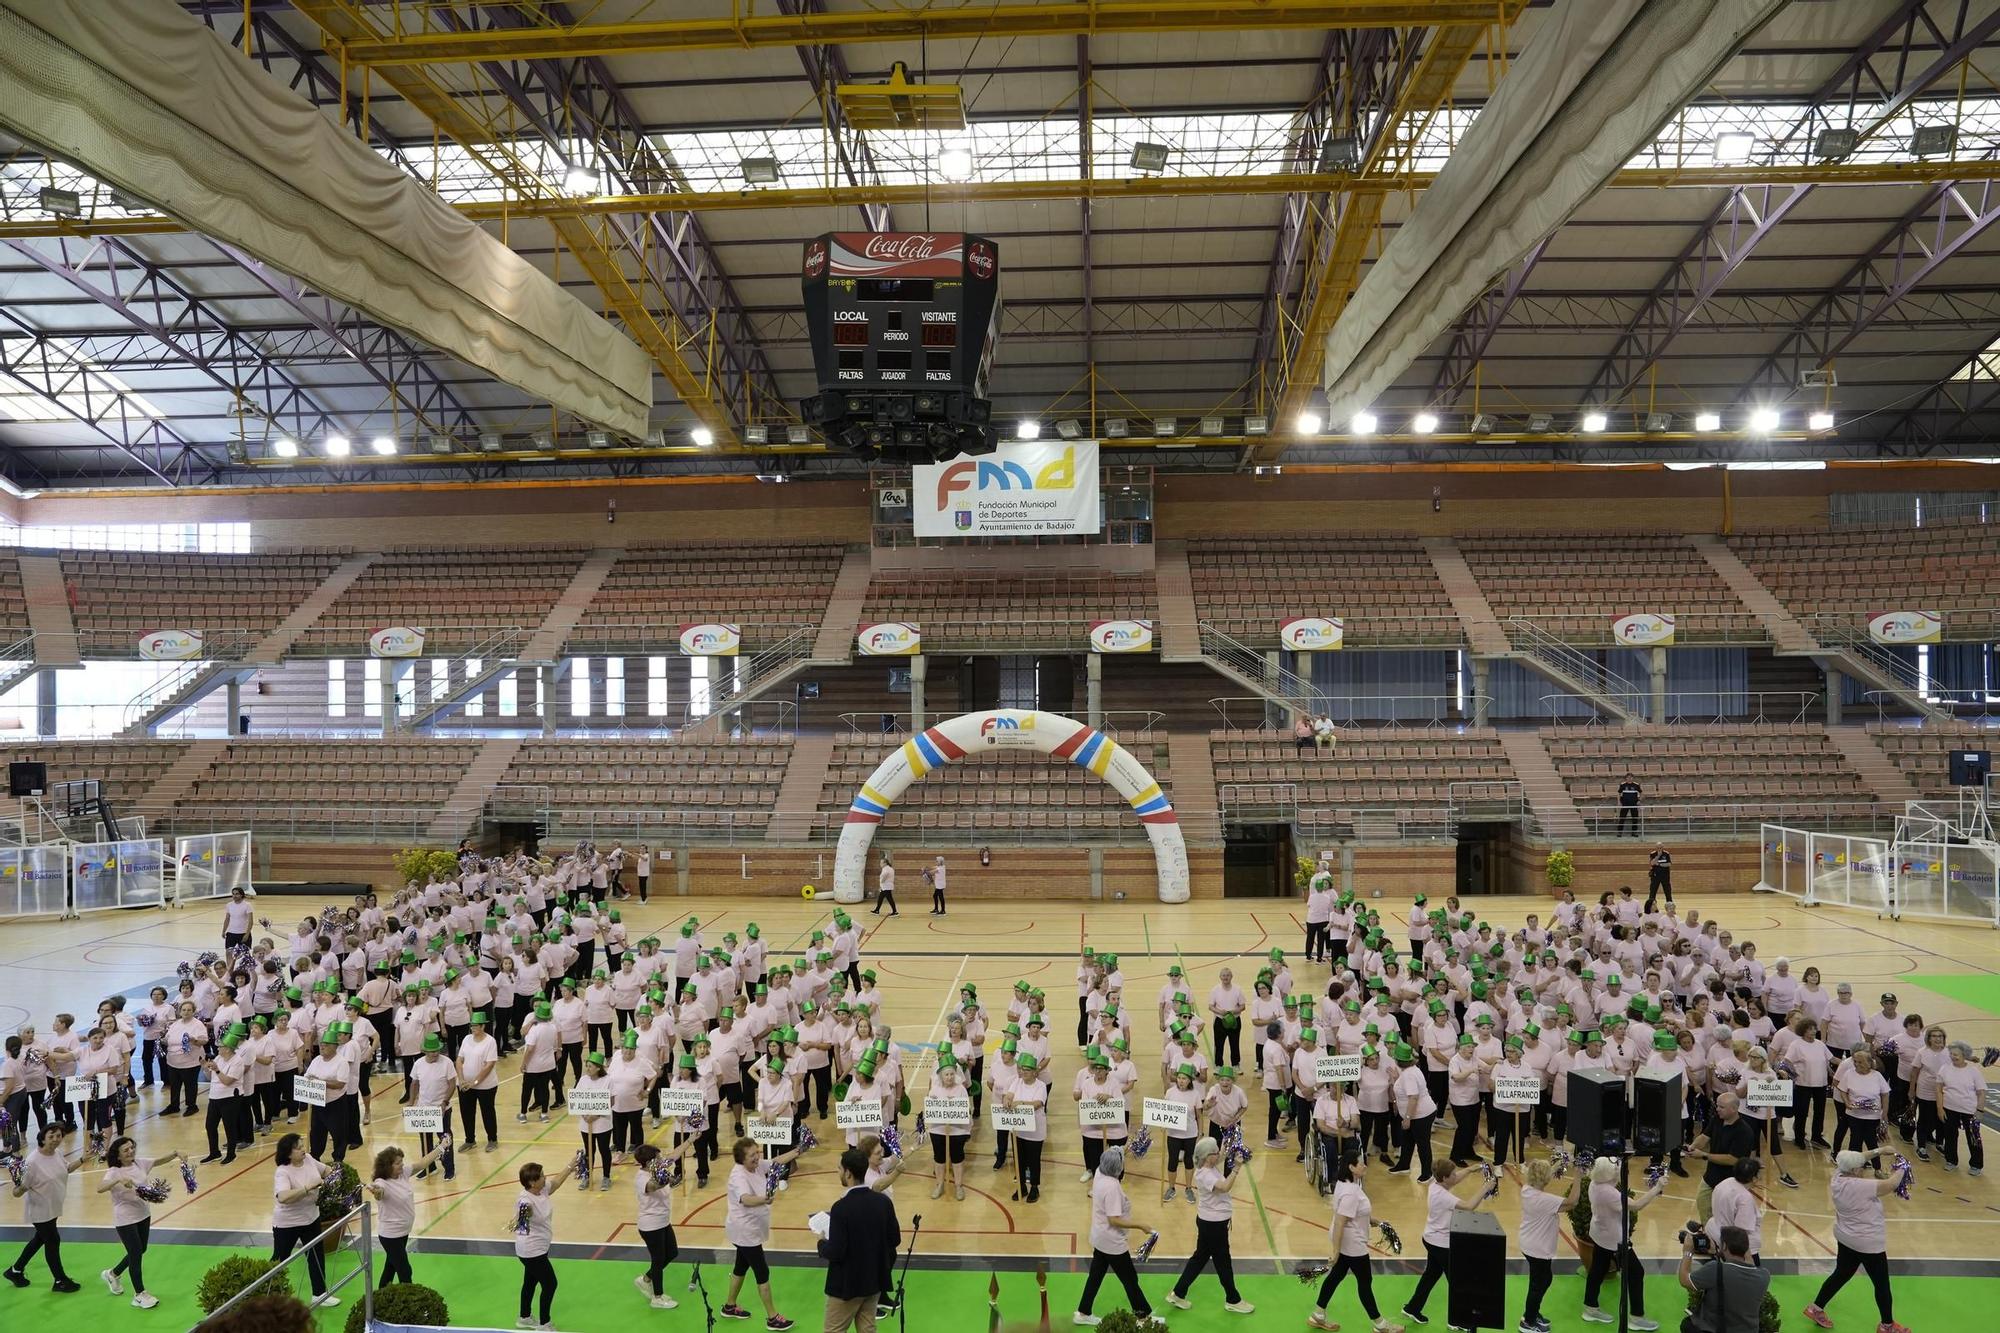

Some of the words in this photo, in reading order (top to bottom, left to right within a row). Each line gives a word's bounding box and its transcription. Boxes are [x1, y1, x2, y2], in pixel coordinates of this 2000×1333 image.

[834, 312, 869, 321] LOCAL
[922, 312, 956, 322] VISITANTE
[883, 332, 909, 340] PERIODO
[838, 371, 864, 380] FALTAS
[881, 372, 906, 380] JUGADOR
[926, 372, 951, 381] FALTAS
[978, 500, 1018, 509] Fundación
[1019, 500, 1057, 510] Municipal
[991, 511, 1028, 520] Deportes
[979, 522, 1032, 532] Ayuntamiento
[1034, 522, 1044, 530] de
[1046, 522, 1076, 531] Badajoz
[1962, 874, 1993, 882] Badajoz
[1318, 1068, 1358, 1078] PARDALERAS
[1758, 1082, 1782, 1091] PABELLÓN
[1497, 1090, 1538, 1099] VILLAFRANCO
[838, 1104, 853, 1112] CENTRO
[1145, 1101, 1160, 1110] CENTRO
[1167, 1104, 1186, 1114] MAYORES
[856, 1114, 881, 1122] LLERA
[943, 1111, 968, 1119] ENGRACIA
[1152, 1112, 1161, 1122] LA
[1163, 1114, 1179, 1124] PAZ
[411, 1120, 436, 1128] NOVELDA
[1001, 1117, 1026, 1126] BALBOA
[753, 1131, 785, 1139] SAGRAJAS
